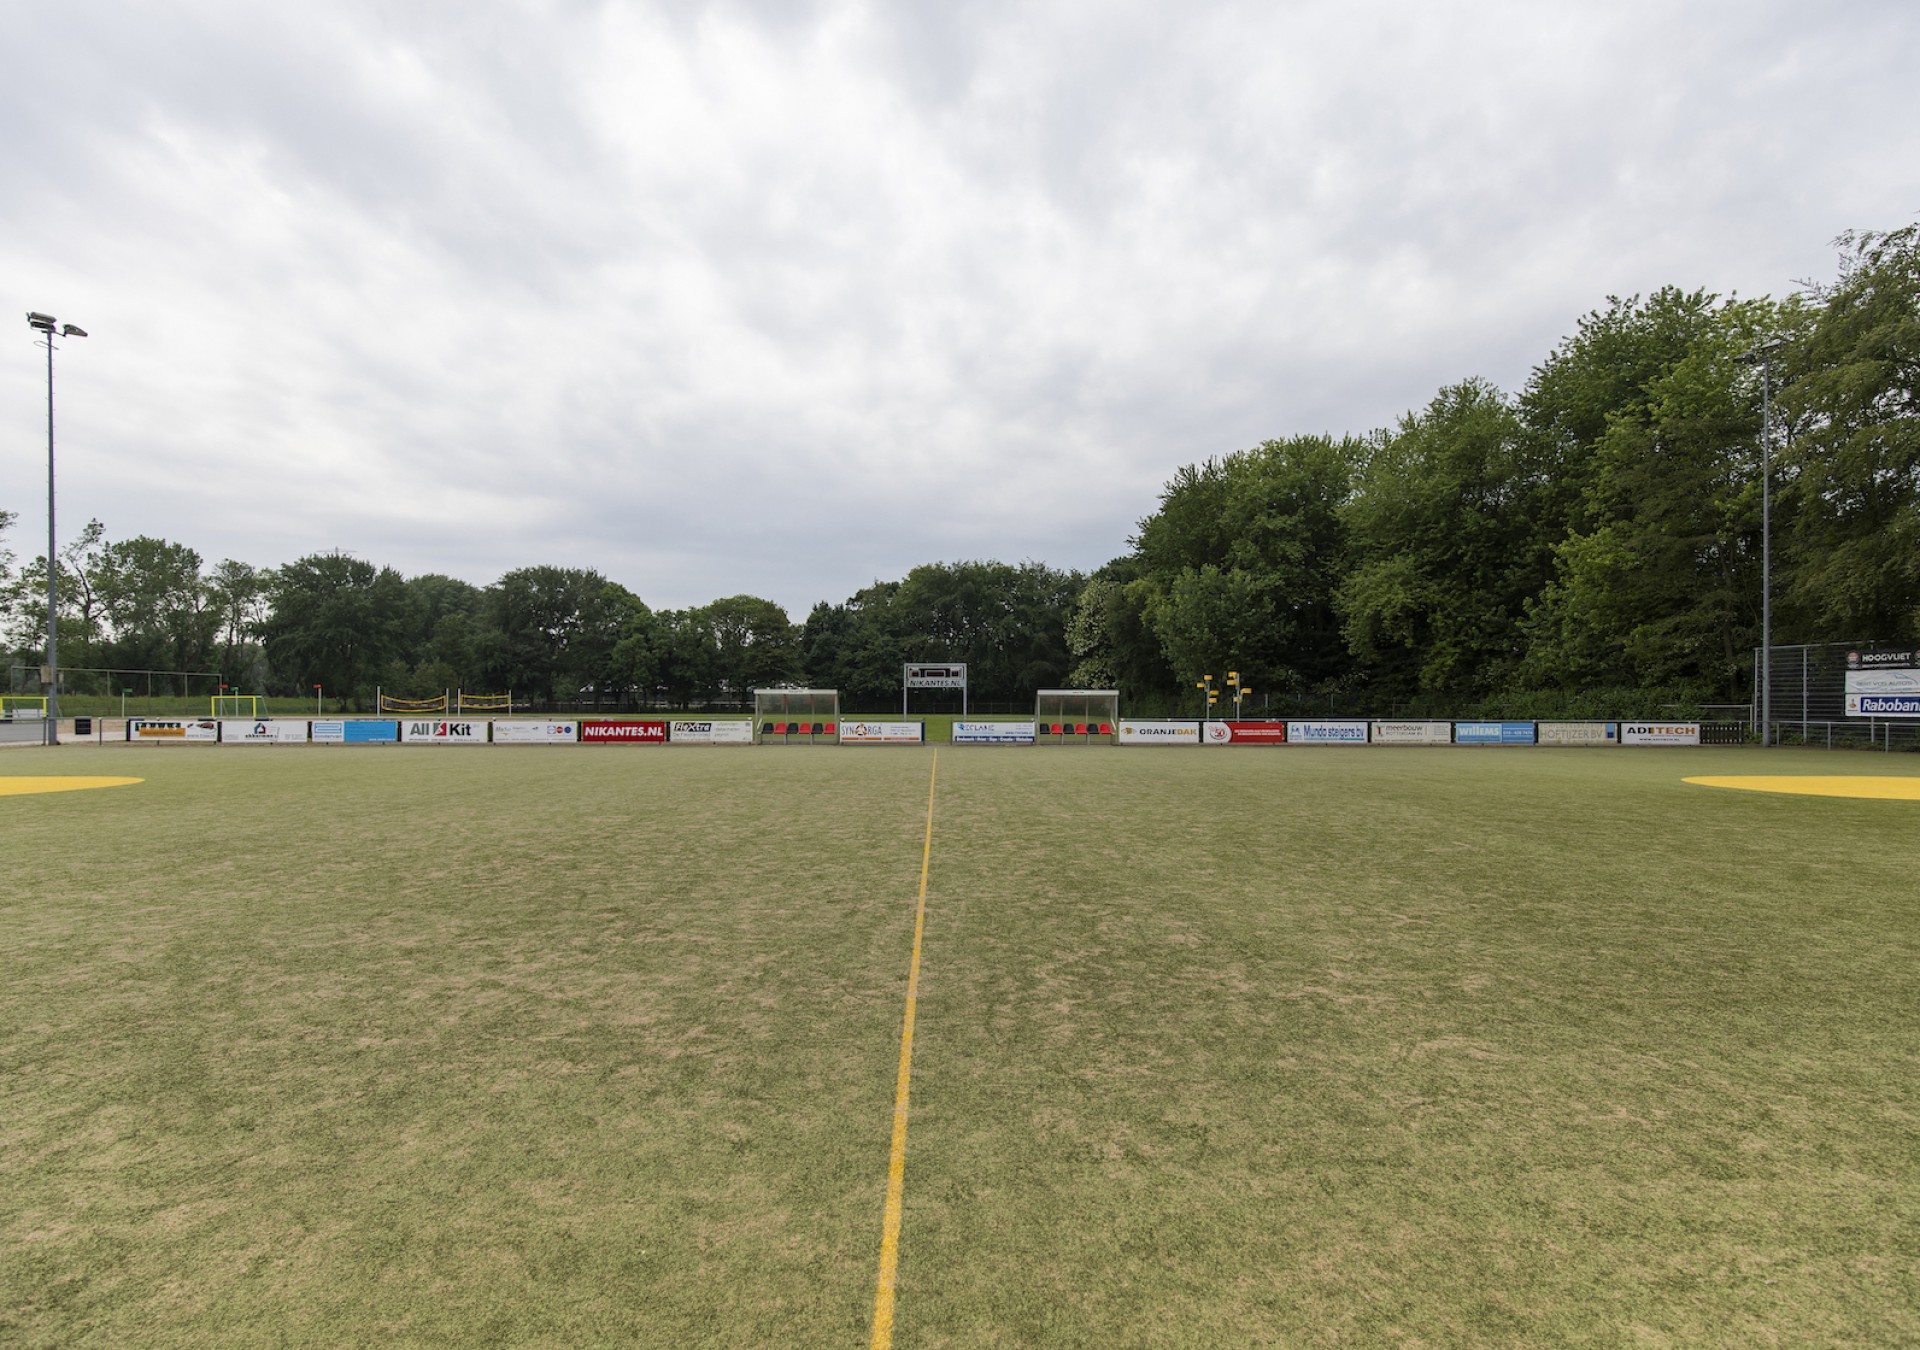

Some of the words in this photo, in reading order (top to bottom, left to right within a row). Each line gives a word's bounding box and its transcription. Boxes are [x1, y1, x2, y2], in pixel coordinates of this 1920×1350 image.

[1862, 653, 1911, 662] HOOGVLIET
[410, 723, 430, 736] All
[449, 723, 471, 736] Kit
[585, 726, 664, 736] NIKANTES.NL
